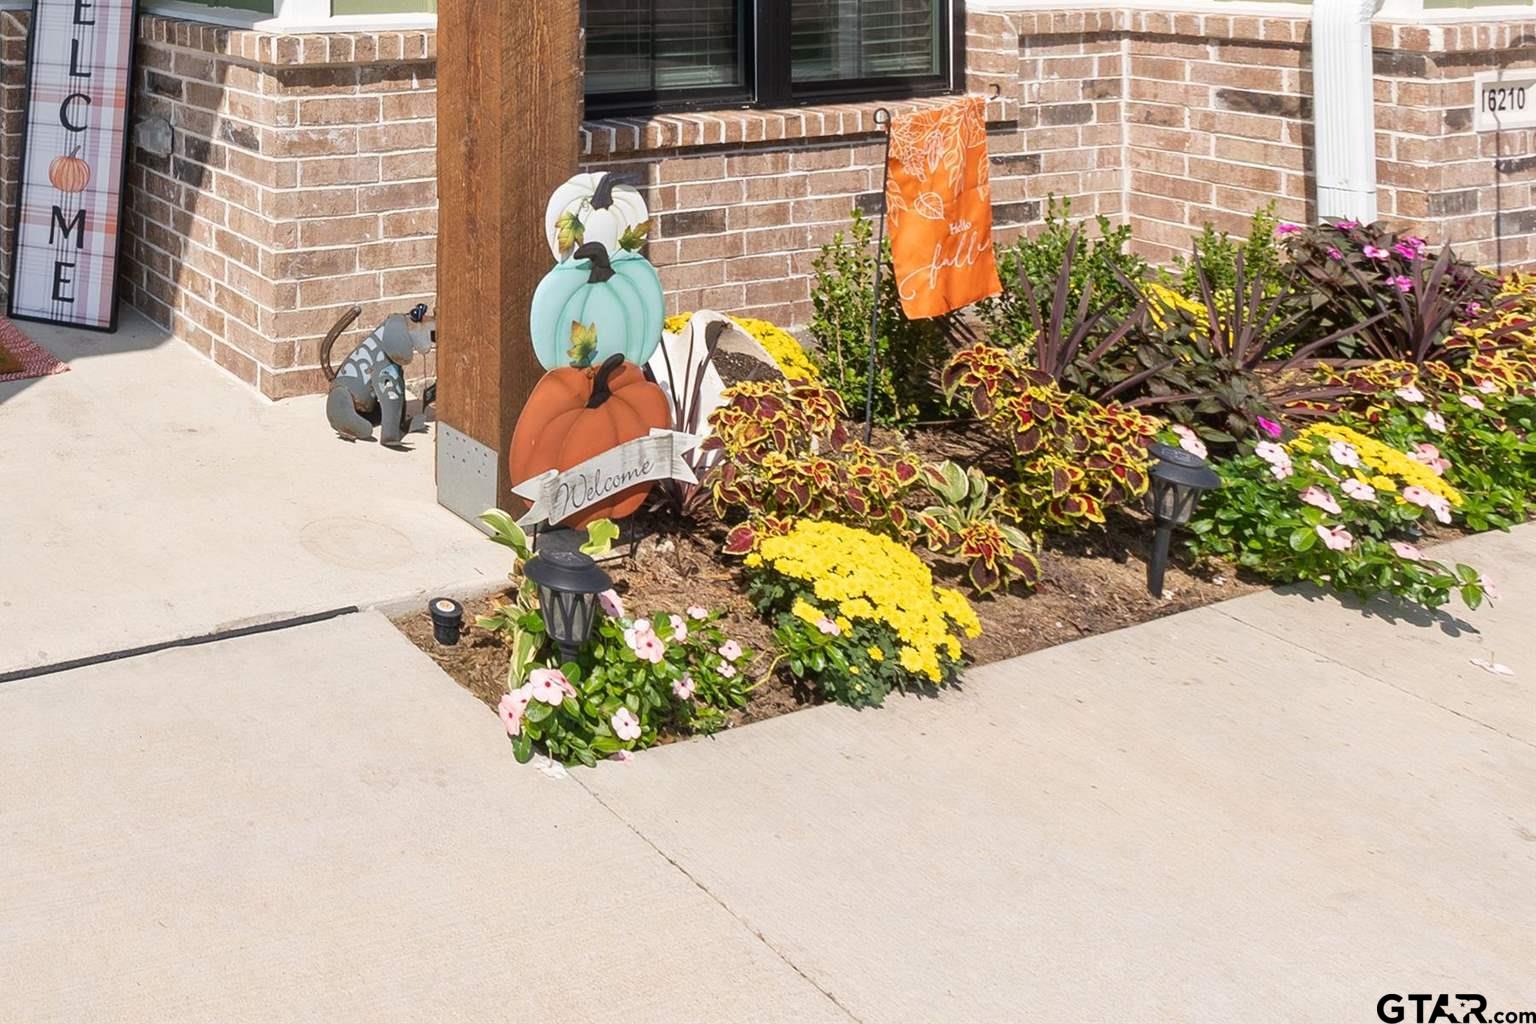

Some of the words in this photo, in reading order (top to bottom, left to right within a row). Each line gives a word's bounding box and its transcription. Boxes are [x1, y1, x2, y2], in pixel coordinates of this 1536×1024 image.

[949, 218, 972, 236] Hello
[898, 230, 991, 301] fall
[554, 459, 655, 509] Welcome
